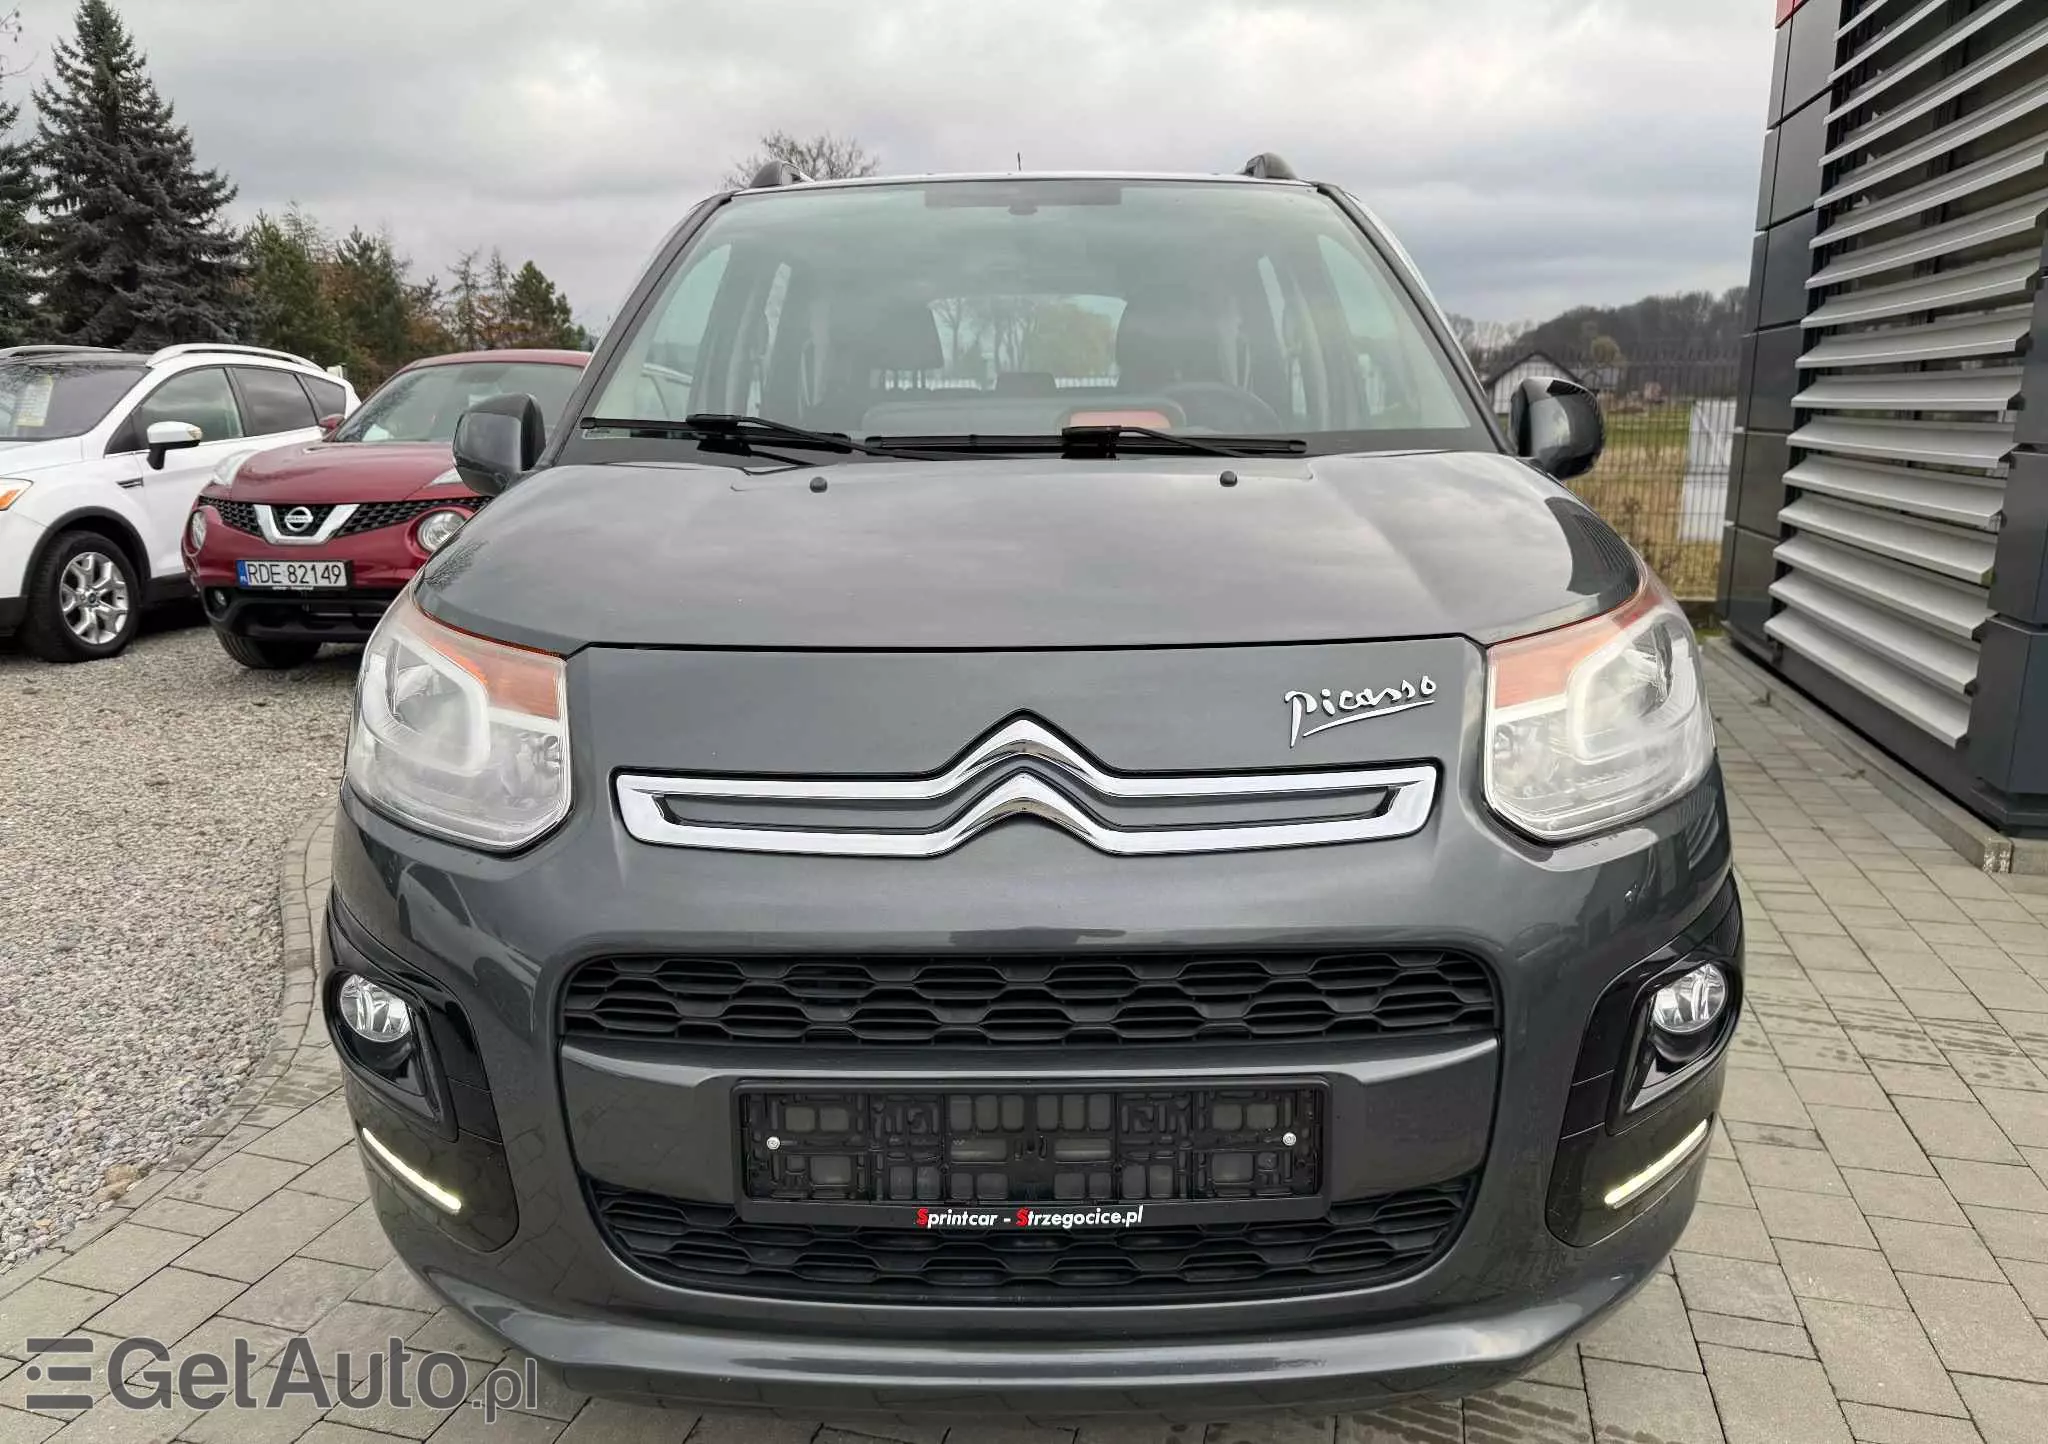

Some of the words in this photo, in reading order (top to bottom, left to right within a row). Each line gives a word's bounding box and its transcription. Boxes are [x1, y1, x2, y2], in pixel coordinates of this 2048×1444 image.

[247, 563, 282, 584] RDE
[287, 564, 341, 585] 82149
[1284, 674, 1437, 748] Picasso
[916, 1208, 998, 1228] Sprintcar
[1016, 1205, 1144, 1228] Strzegocice.pl
